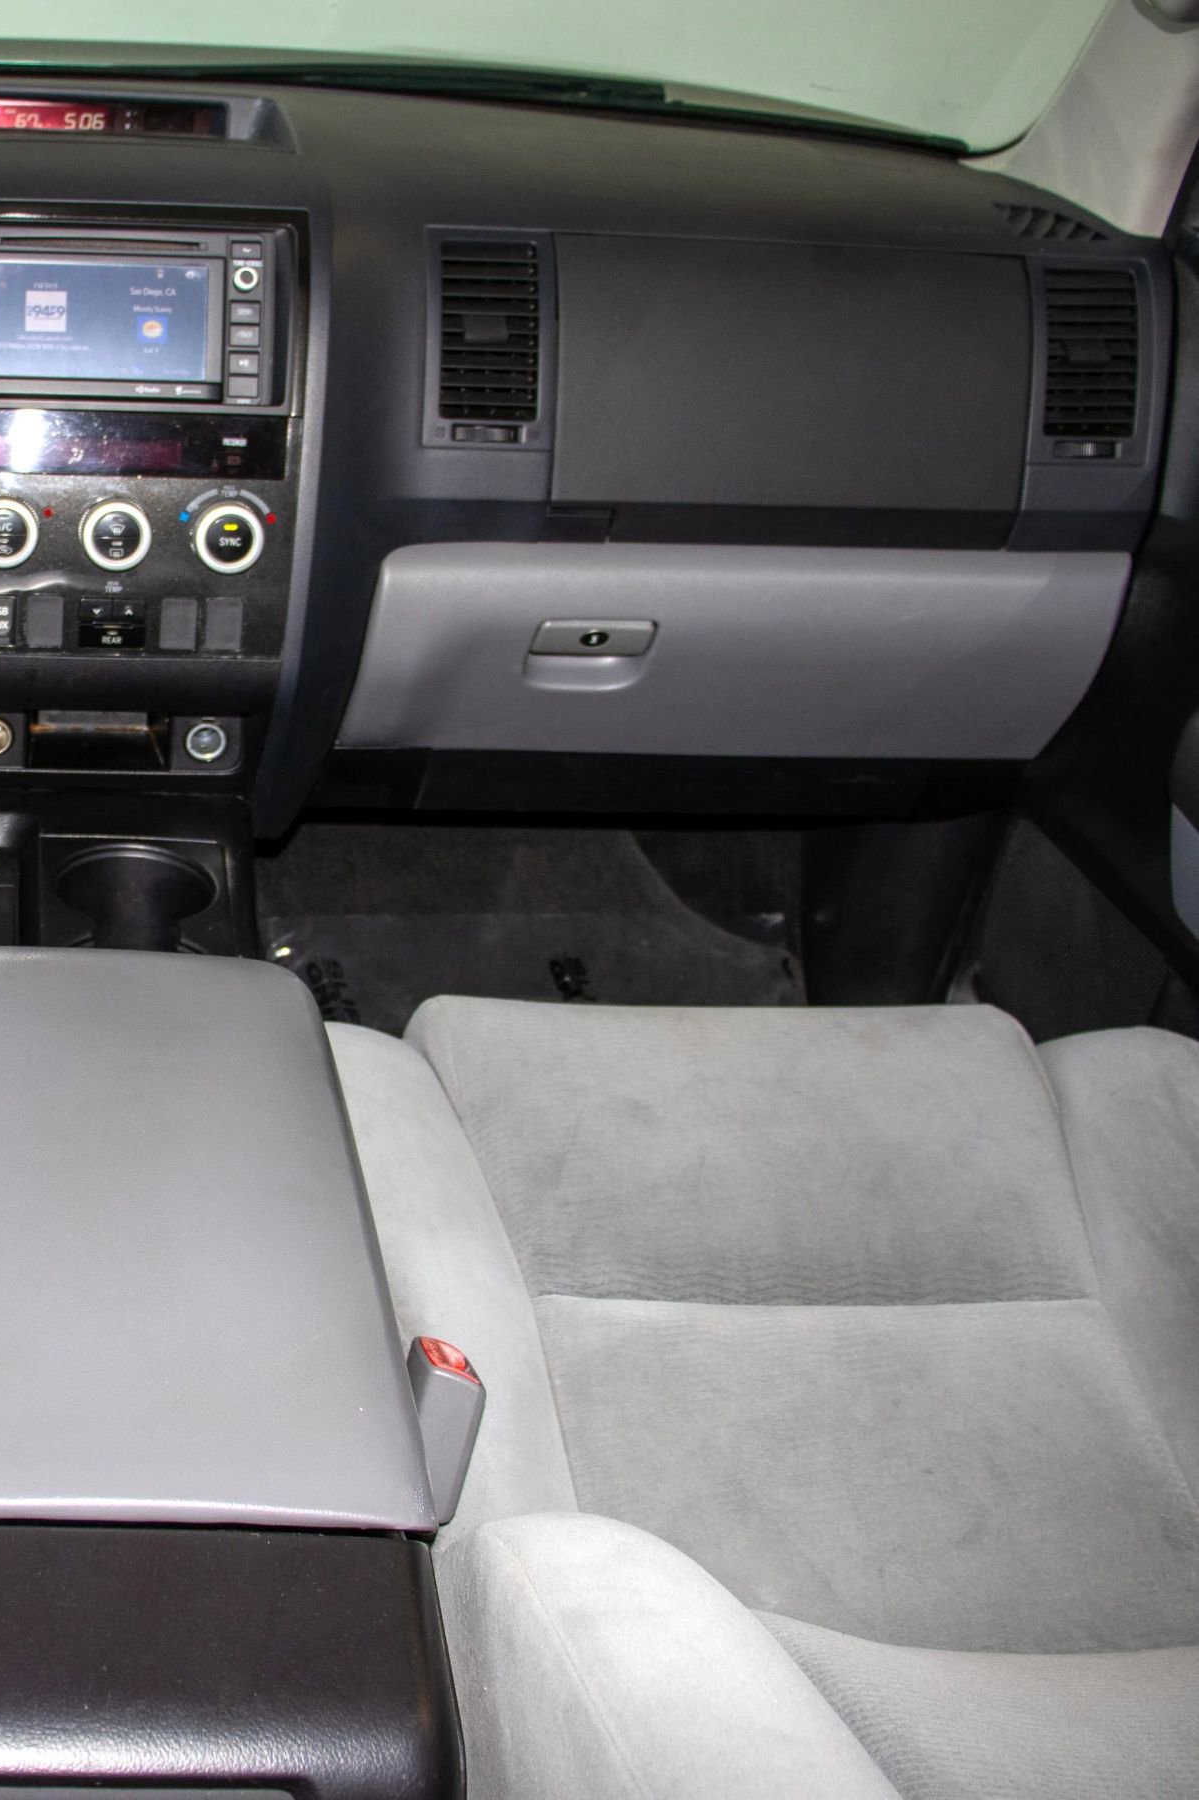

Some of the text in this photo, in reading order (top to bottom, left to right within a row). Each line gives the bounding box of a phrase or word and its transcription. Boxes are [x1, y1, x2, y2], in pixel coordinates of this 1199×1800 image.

[165, 288, 177, 297] CA
[219, 537, 242, 547] SYNC
[101, 636, 122, 644] REAR
